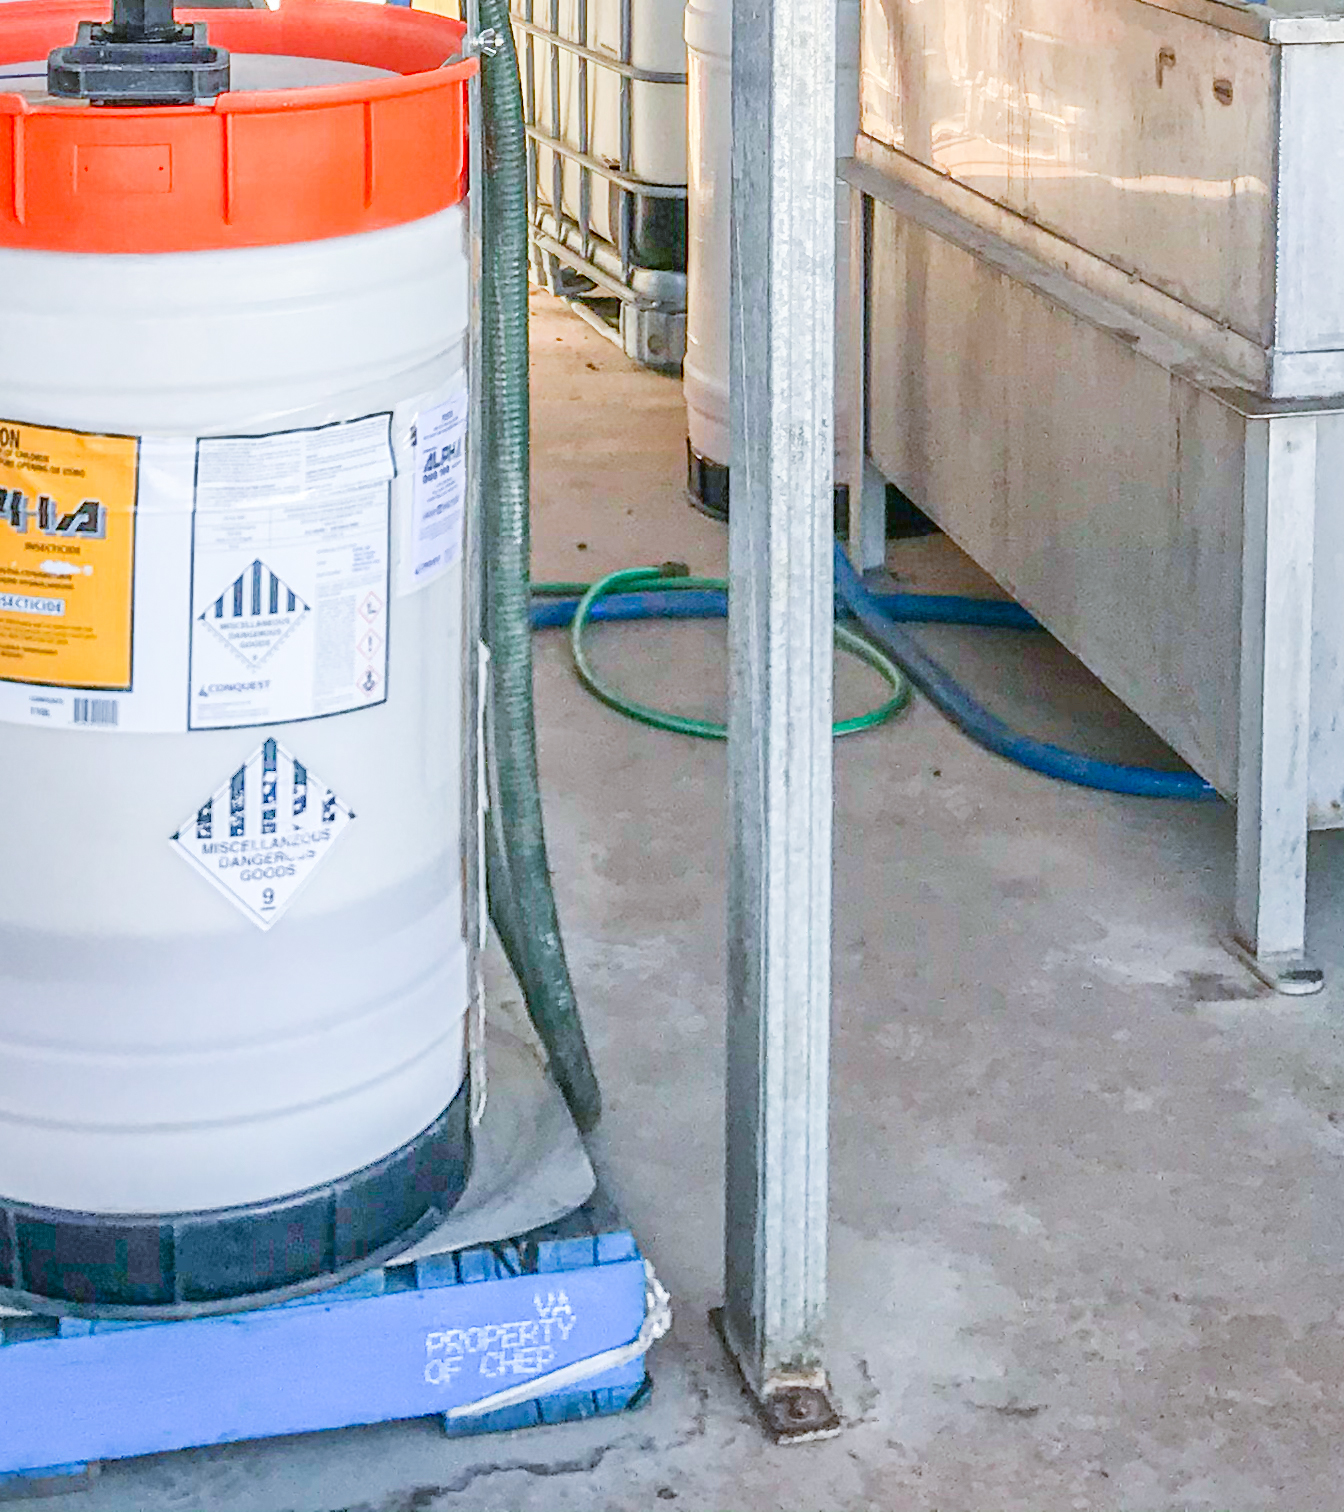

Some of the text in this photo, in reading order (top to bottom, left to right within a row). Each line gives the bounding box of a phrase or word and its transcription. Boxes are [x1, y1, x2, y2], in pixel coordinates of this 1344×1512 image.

[423, 437, 462, 473] ALPH
[239, 864, 297, 882] GOODS
[262, 887, 275, 905] 9
[425, 1314, 577, 1359] PROPERTY
[424, 1344, 556, 1385] OF CHEP
